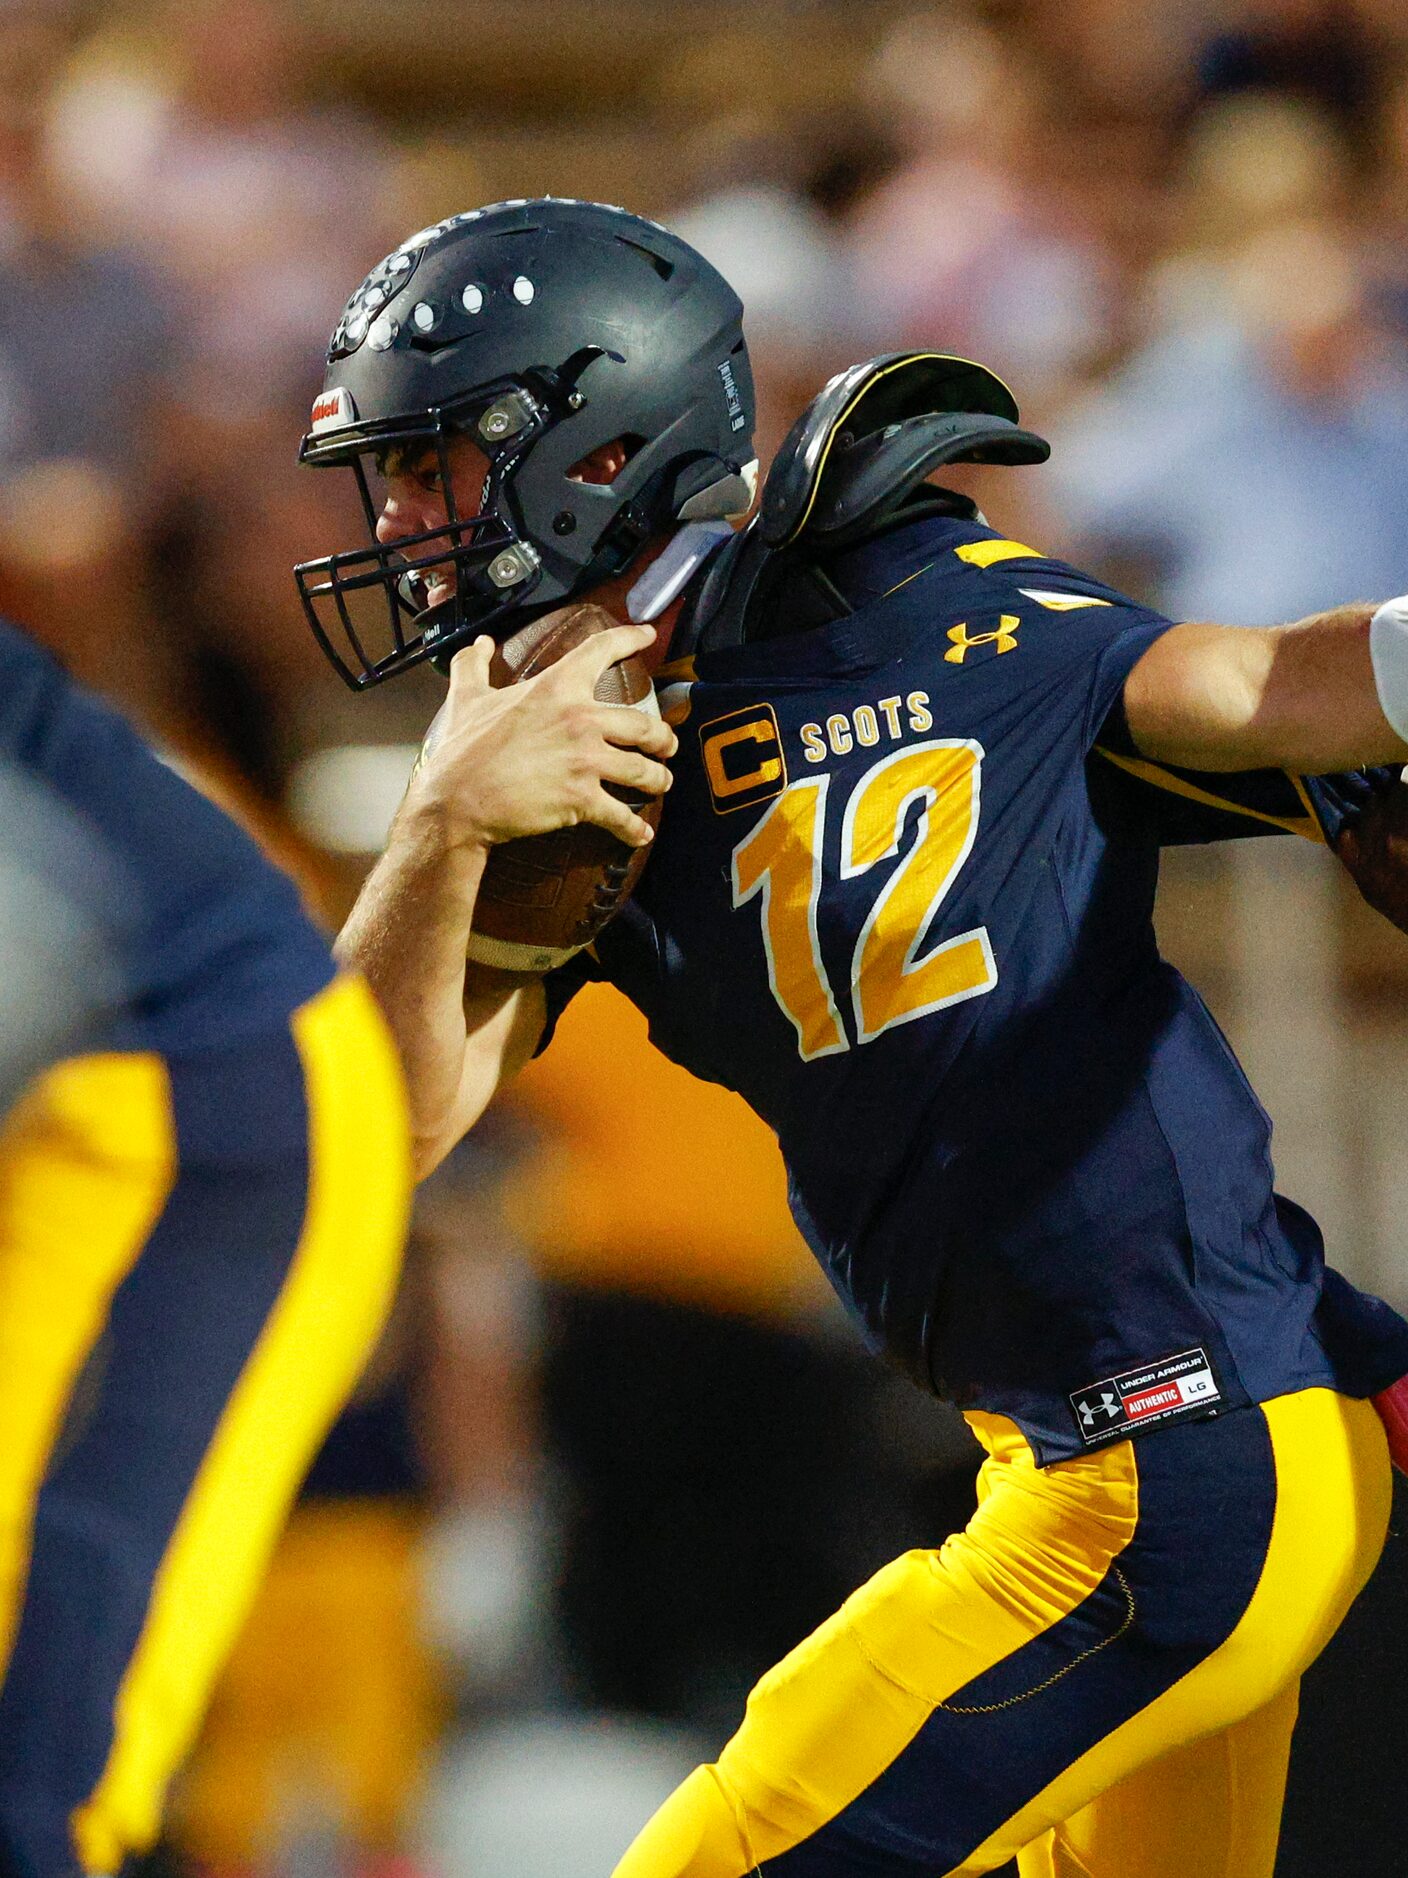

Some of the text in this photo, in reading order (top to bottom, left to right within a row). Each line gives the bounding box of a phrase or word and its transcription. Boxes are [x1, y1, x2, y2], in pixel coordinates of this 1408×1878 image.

[799, 690, 933, 763] SCOTS
[704, 719, 783, 797] C
[730, 737, 998, 1062] 12
[1121, 1357, 1202, 1389] UNDER ARMOUR
[1129, 1382, 1207, 1414] AUTHENTIC LG
[1120, 1415, 1161, 1432] GUARANTEE
[1163, 1410, 1173, 1418] OF
[1173, 1395, 1221, 1415] PERFORMANCE
